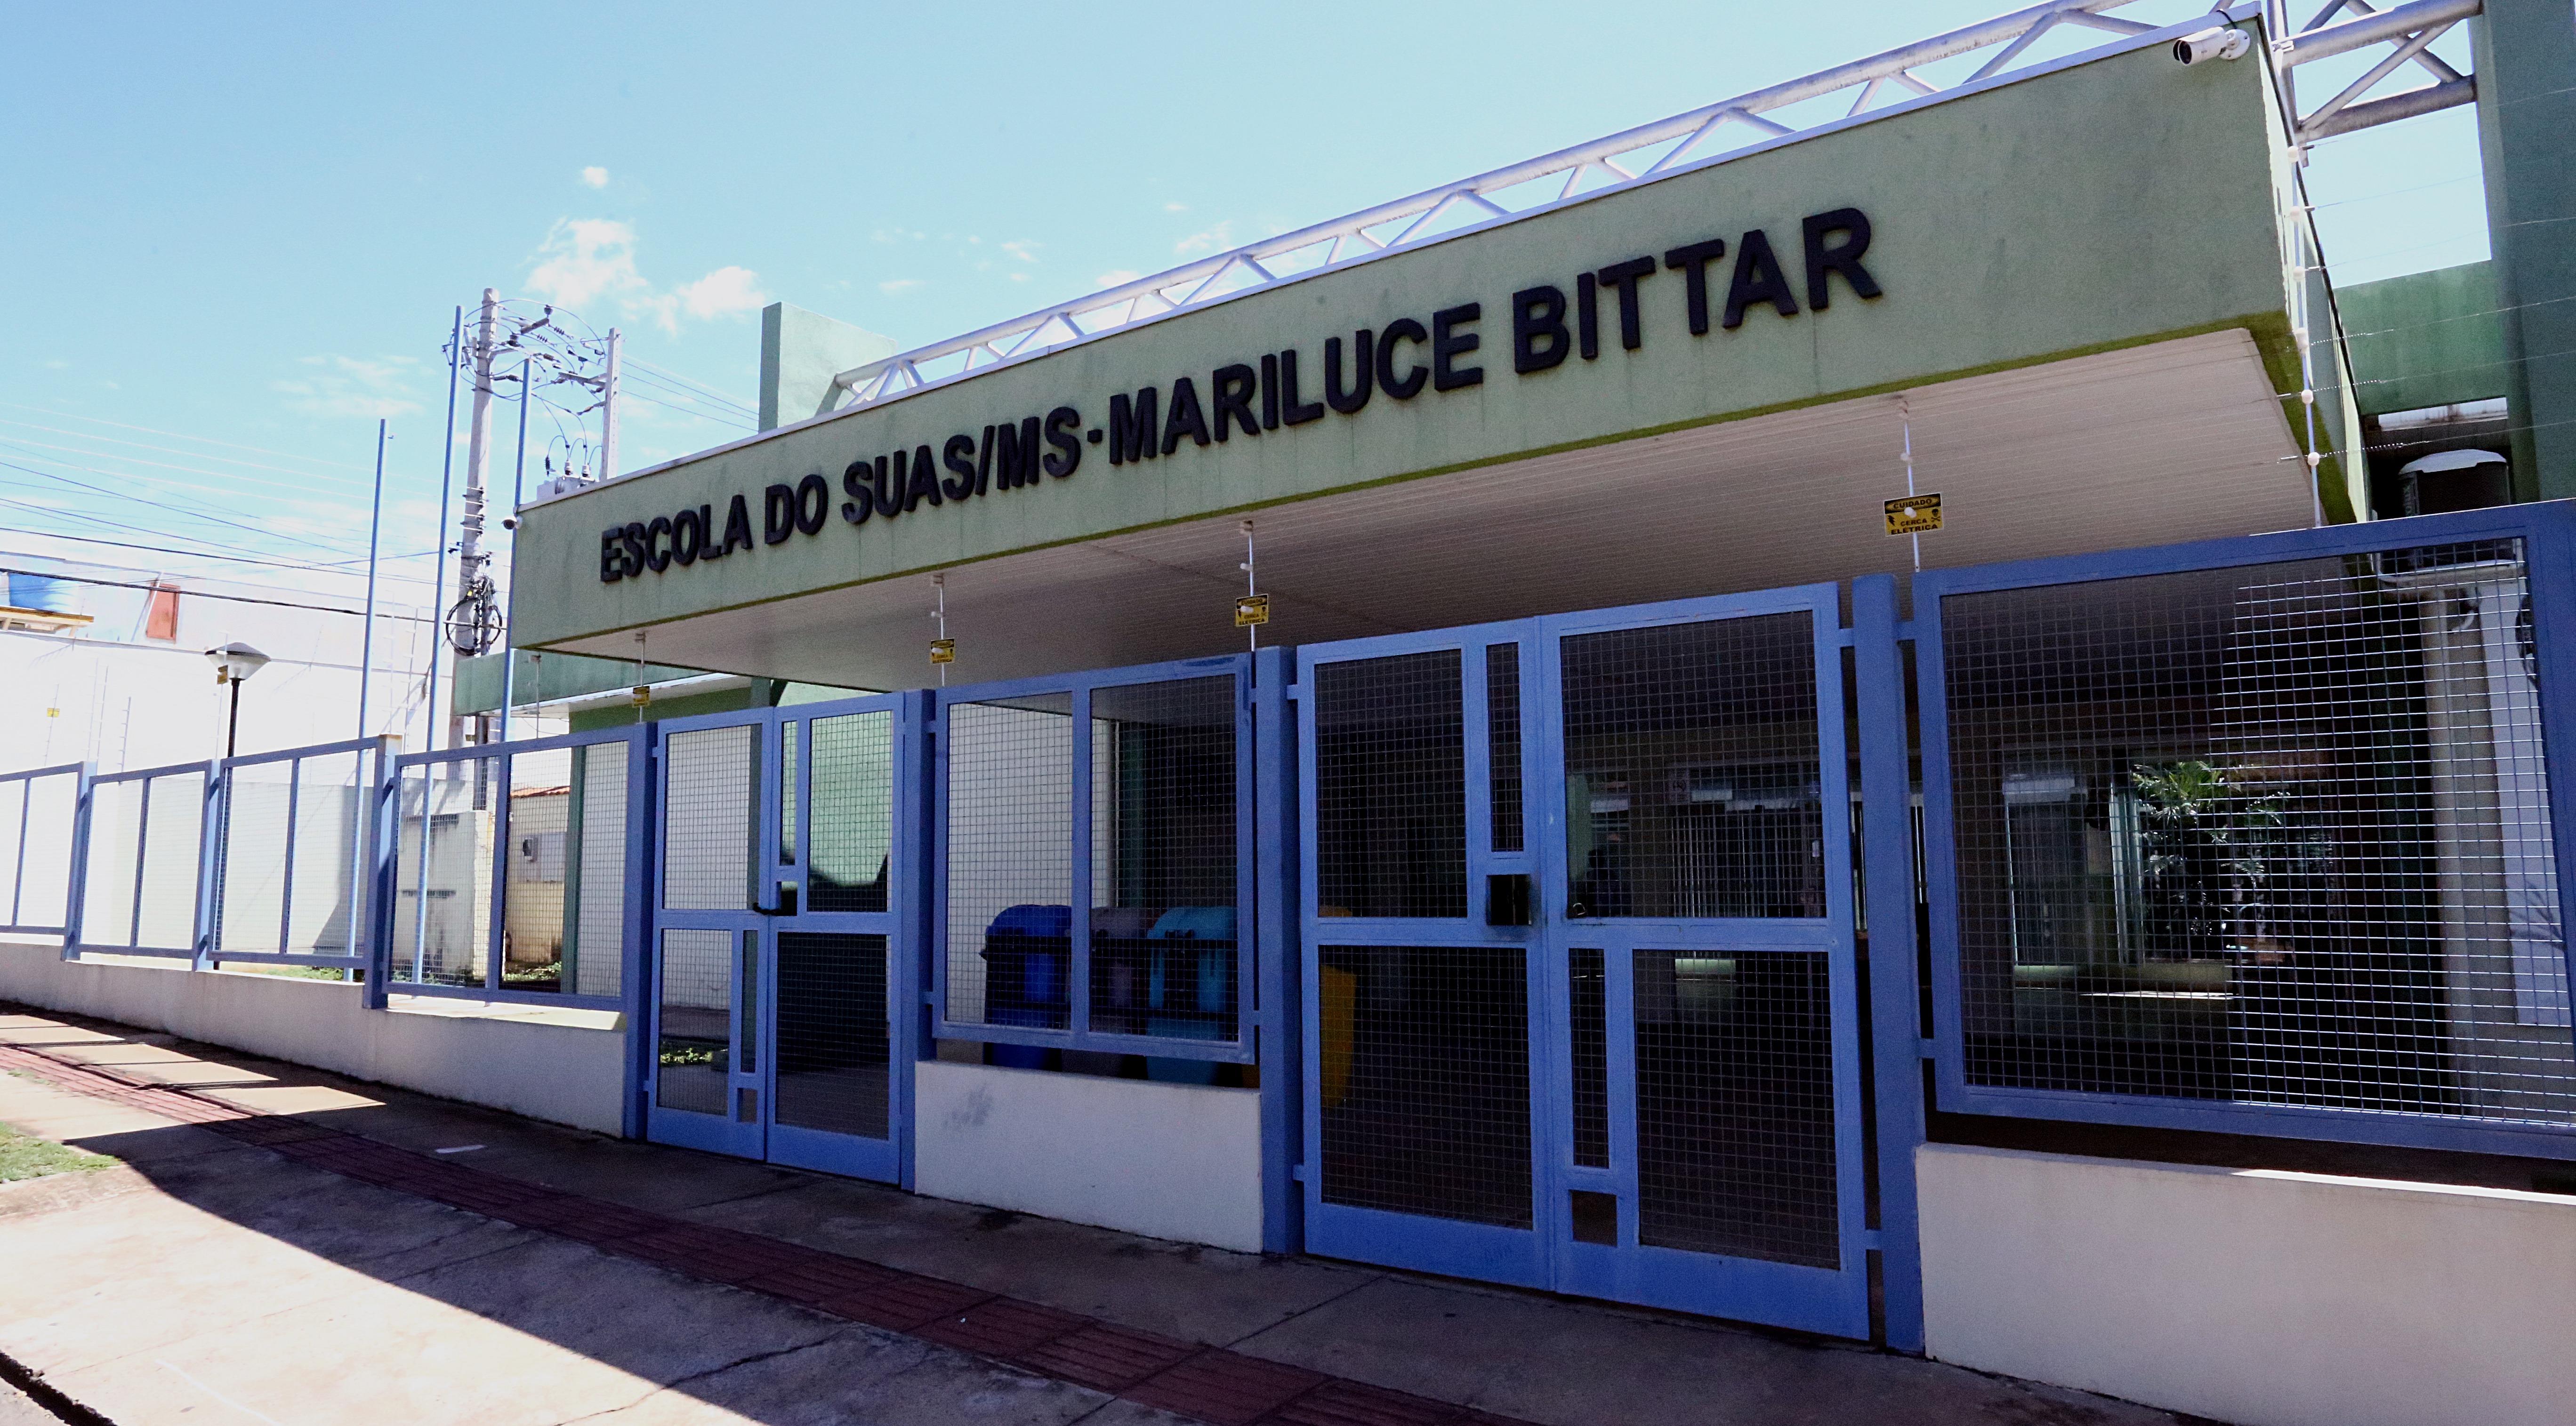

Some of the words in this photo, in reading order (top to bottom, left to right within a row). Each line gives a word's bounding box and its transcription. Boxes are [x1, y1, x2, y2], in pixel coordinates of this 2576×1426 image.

[601, 495, 754, 585] ESCOLA
[765, 474, 829, 547] DO
[1513, 207, 1884, 377] BITTAR
[1893, 498, 1932, 509] CUIDADO
[1900, 518, 1927, 527] CERCA
[1891, 524, 1938, 535] ELETRICA
